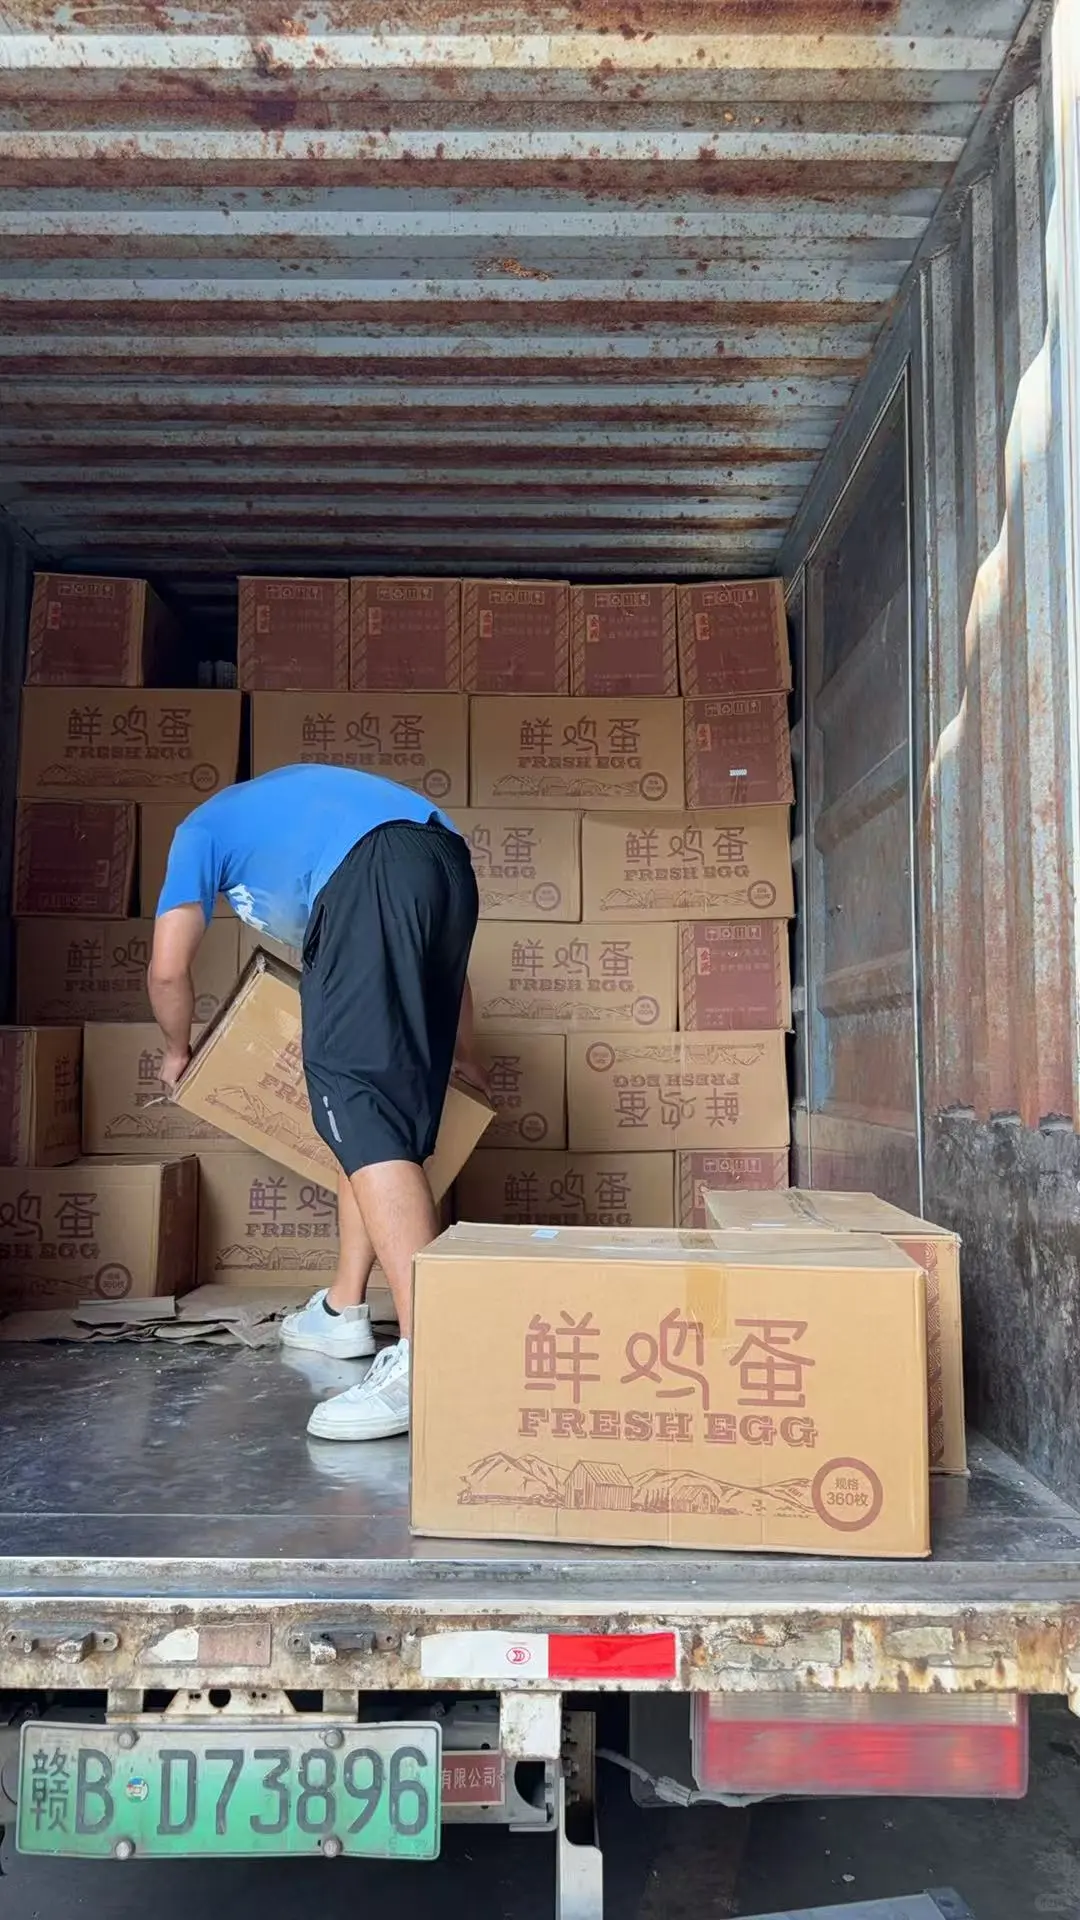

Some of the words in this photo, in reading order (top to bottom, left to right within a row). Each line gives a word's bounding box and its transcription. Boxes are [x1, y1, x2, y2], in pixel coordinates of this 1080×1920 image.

[245, 1222, 331, 1238] FRESH
[38, 1242, 100, 1260] EGG
[524, 1307, 817, 1411] 鲜鸡蛋
[518, 1406, 694, 1442] FRESH
[703, 1411, 819, 1449] EGG
[835, 1477, 860, 1491] 规格
[826, 1491, 869, 1507] 360枚
